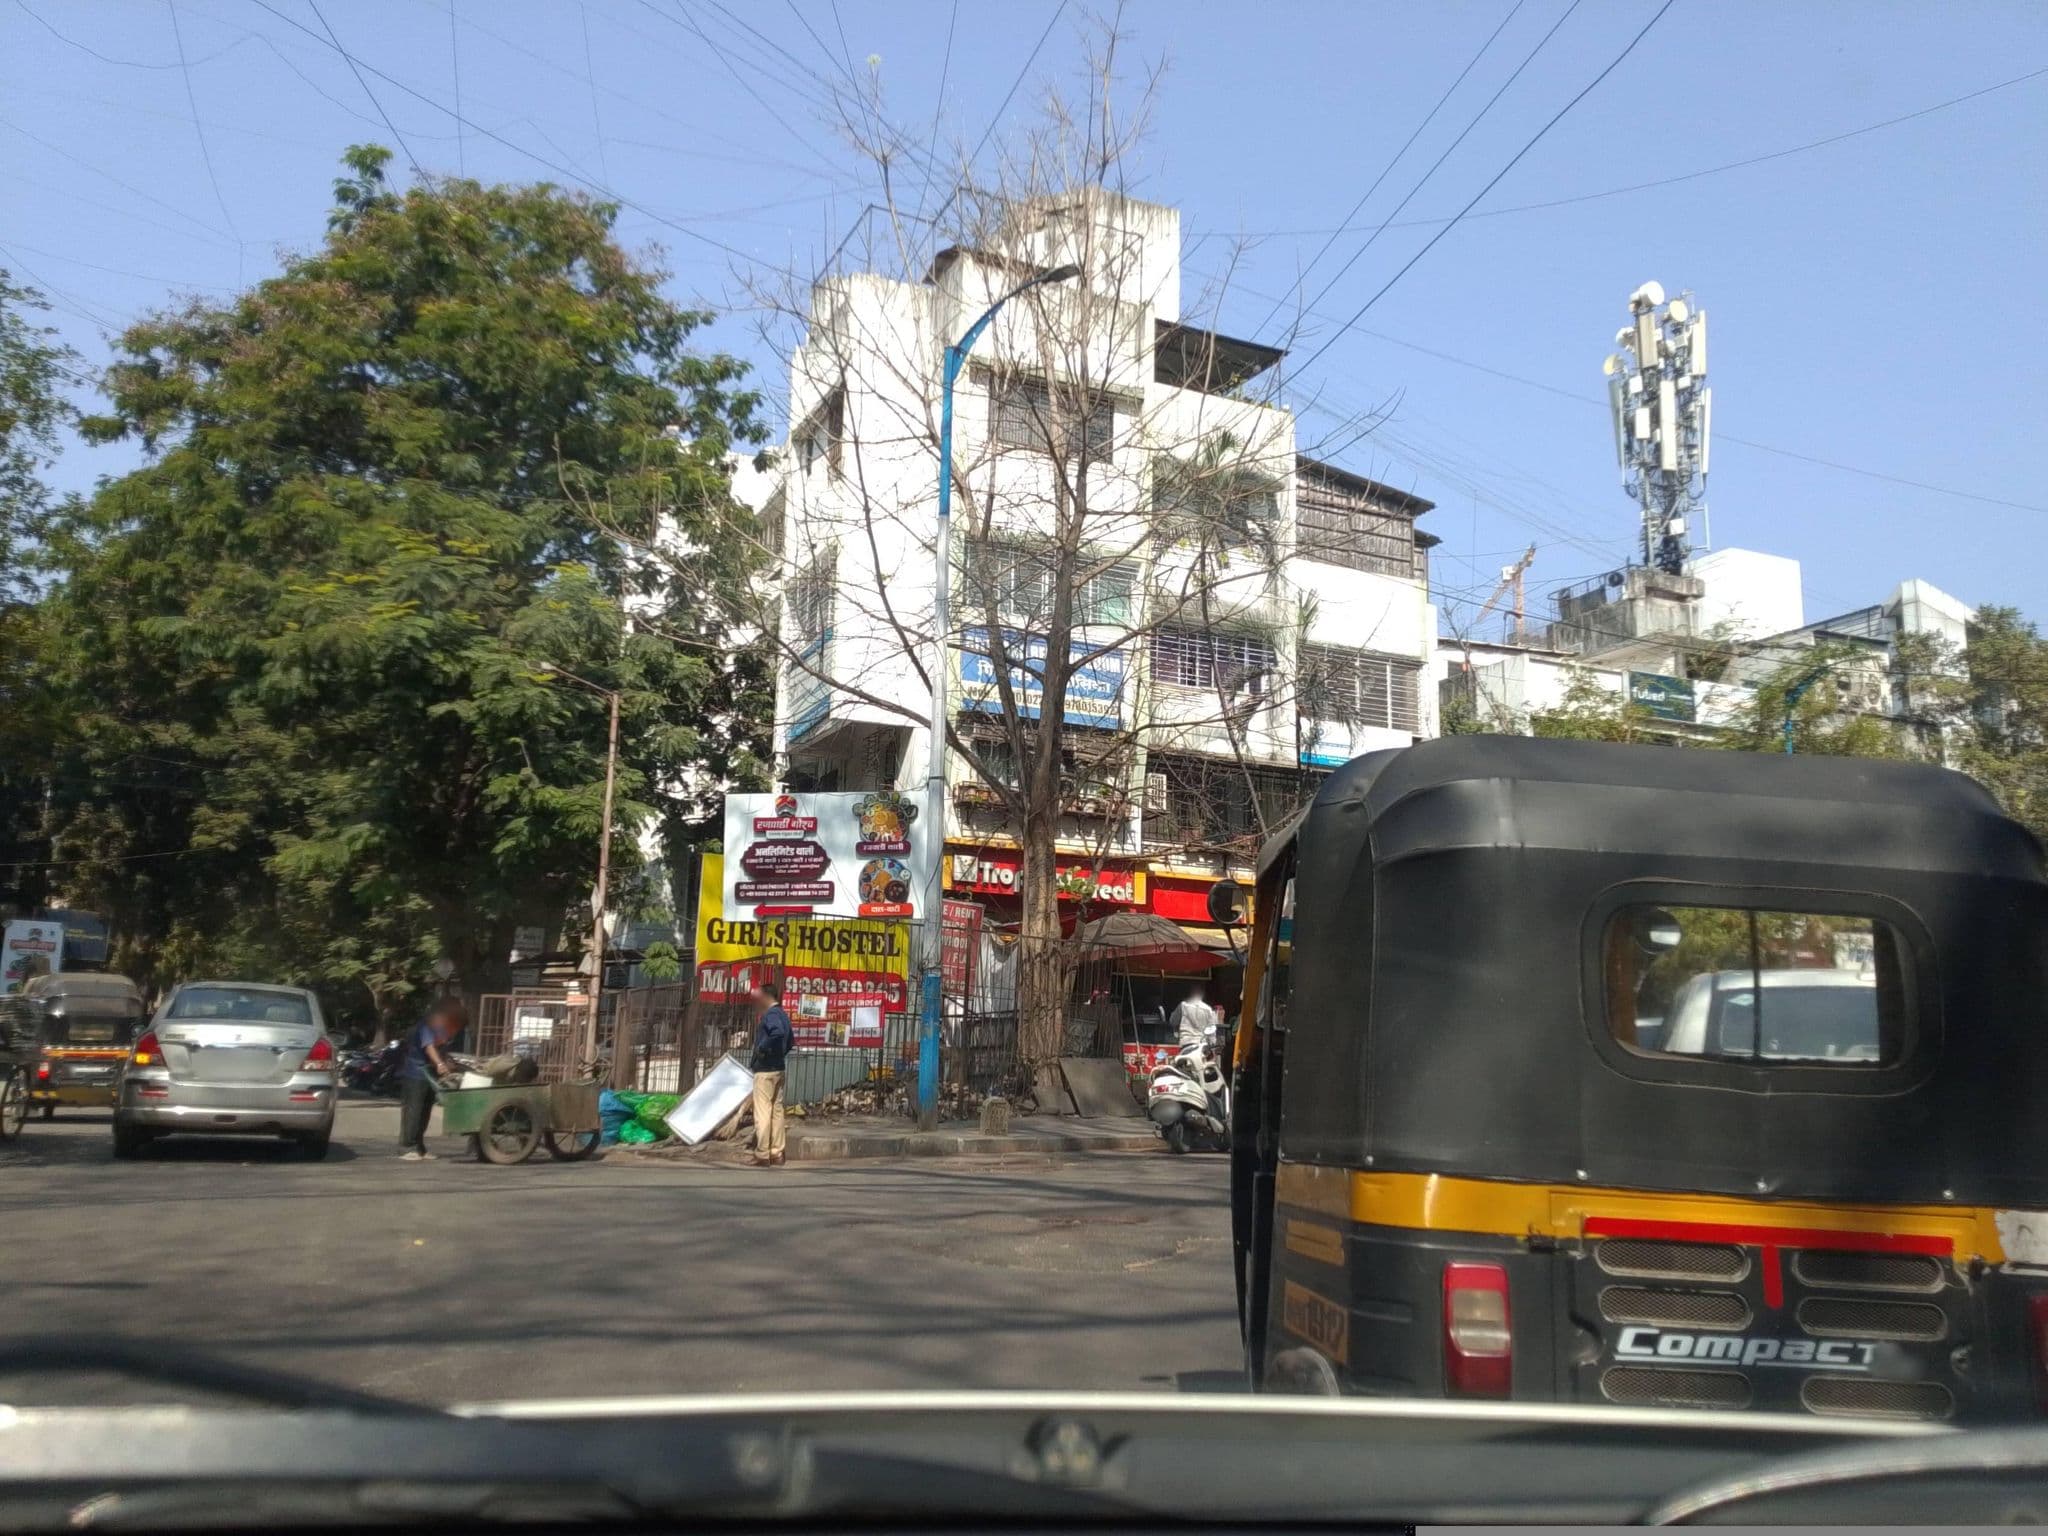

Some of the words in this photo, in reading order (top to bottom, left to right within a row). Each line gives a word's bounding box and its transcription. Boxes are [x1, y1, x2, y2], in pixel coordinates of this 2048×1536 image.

[796, 845, 814, 856] थाली
[955, 907, 976, 920] RENT
[707, 917, 790, 948] GIRLS
[797, 925, 901, 957] HOSTEL
